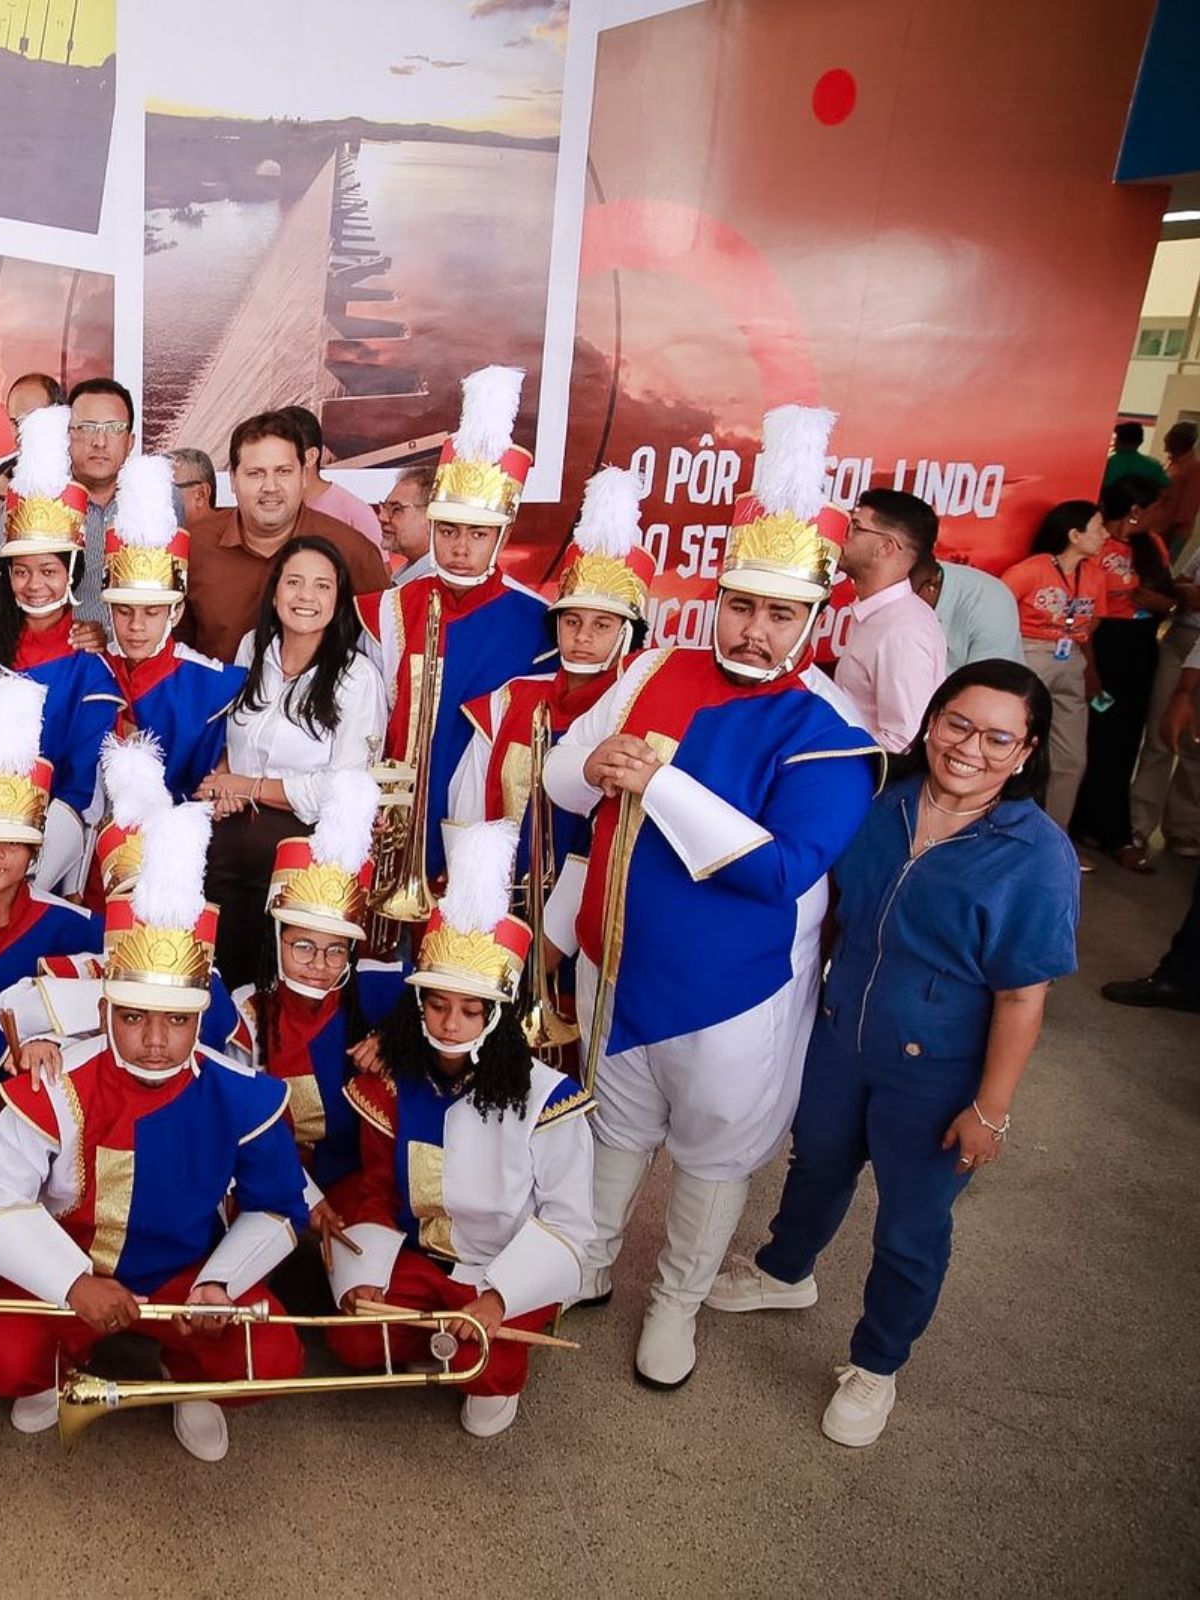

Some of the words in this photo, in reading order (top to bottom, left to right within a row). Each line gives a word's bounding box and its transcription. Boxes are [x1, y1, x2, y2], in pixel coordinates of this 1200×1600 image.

[629, 445, 657, 502] O
[663, 432, 742, 507] PÔR
[892, 458, 1006, 519] LINDO
